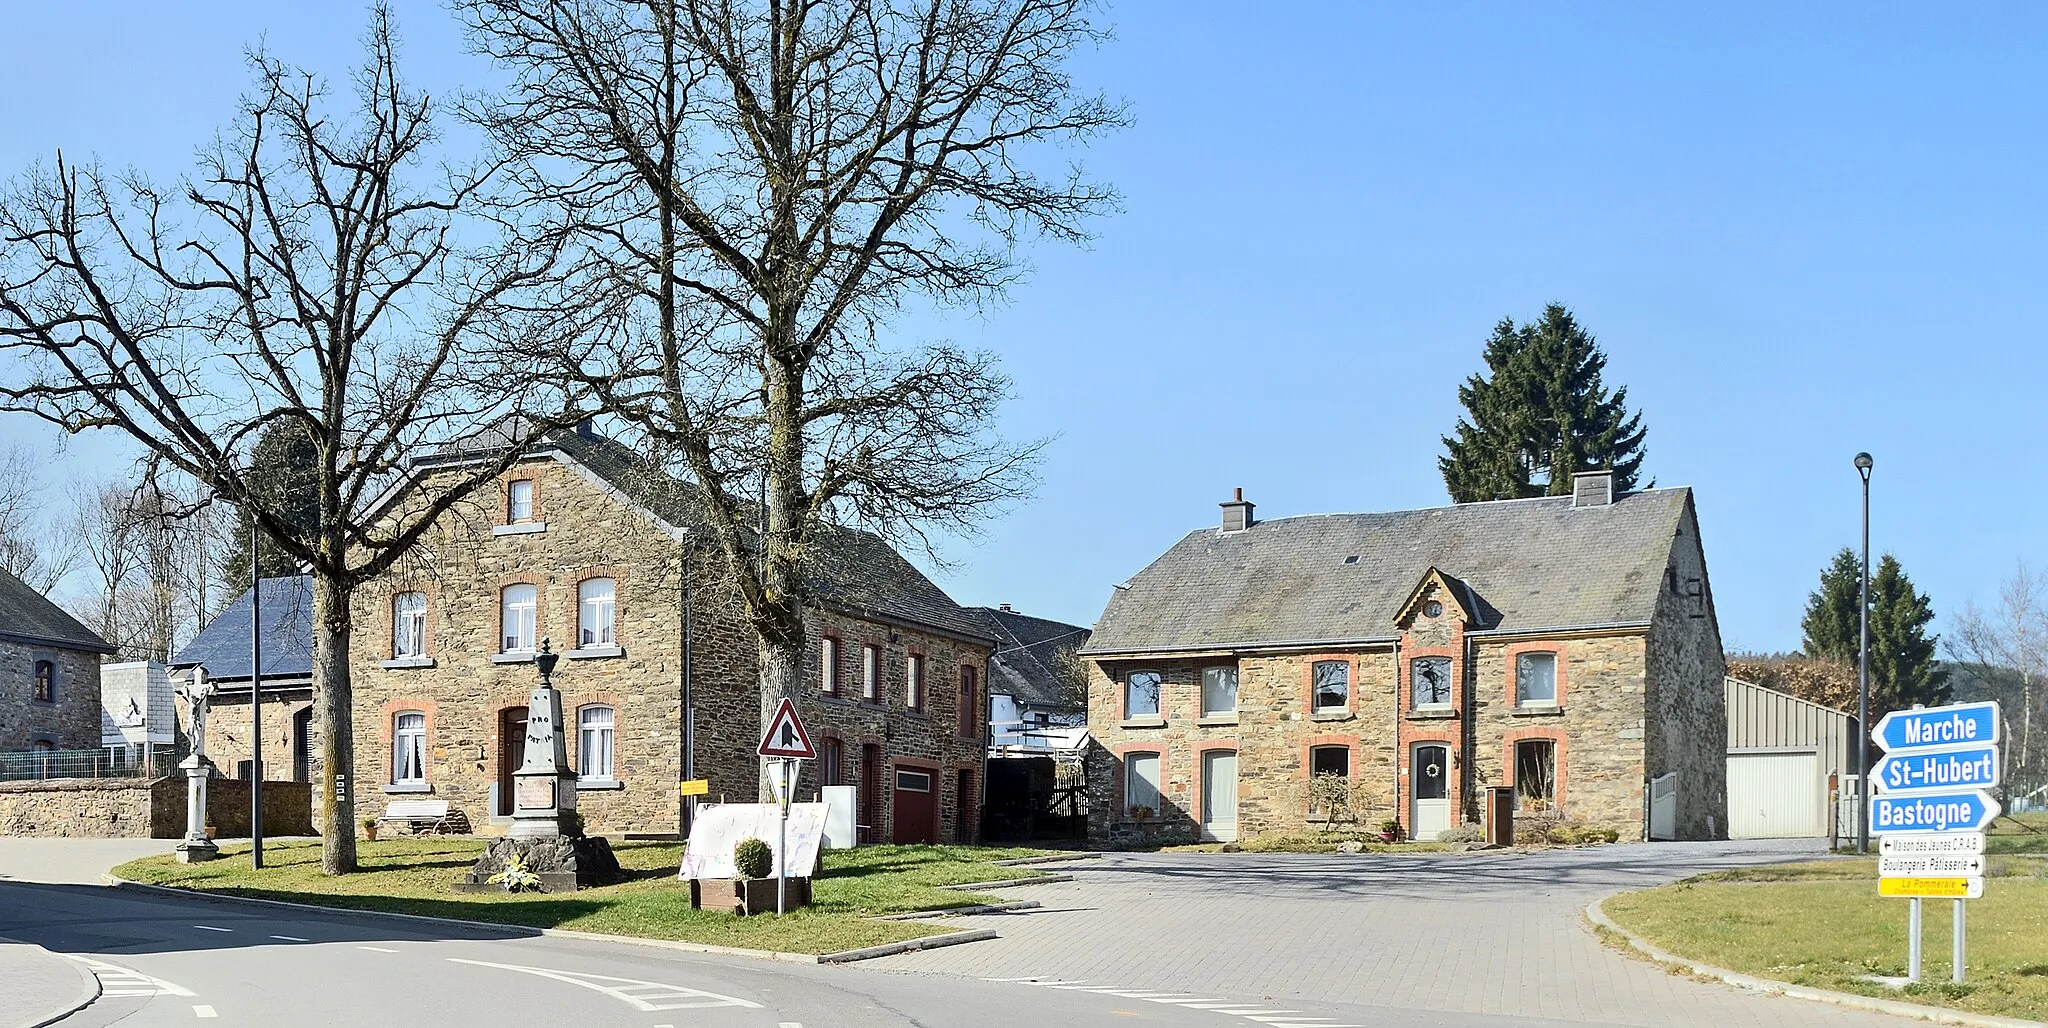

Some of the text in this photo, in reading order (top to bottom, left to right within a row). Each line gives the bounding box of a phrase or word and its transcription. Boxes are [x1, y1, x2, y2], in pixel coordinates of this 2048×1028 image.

[531, 716, 549, 724] PRO
[1905, 713, 1977, 744] Marche
[1889, 753, 1992, 787] St-Hubert
[1879, 799, 1971, 831] Bastogne
[1893, 840, 1915, 852] Maison
[1916, 839, 1927, 851] des
[1928, 839, 1951, 851] Jeunes
[1883, 857, 1968, 874] Boulangerie Pâtisserie
